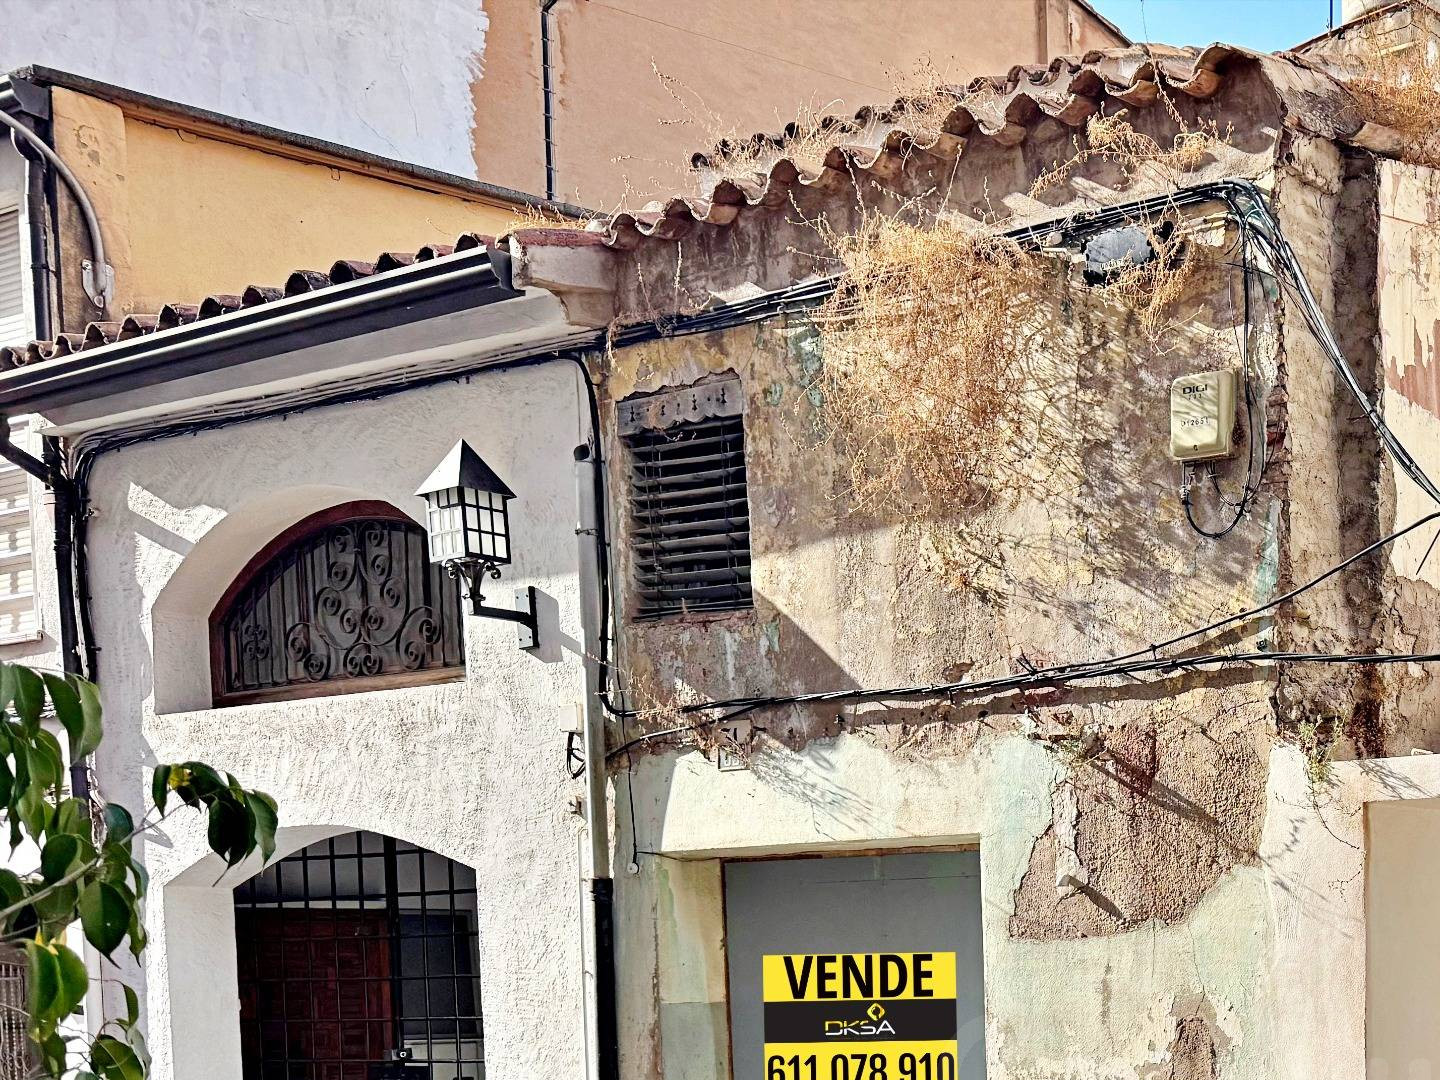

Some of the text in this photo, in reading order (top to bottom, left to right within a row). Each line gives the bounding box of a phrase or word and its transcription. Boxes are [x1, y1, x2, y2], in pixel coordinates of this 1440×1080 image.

[1183, 384, 1208, 395] DIGI
[783, 954, 933, 999] VENDE
[825, 1020, 895, 1035] DKSA
